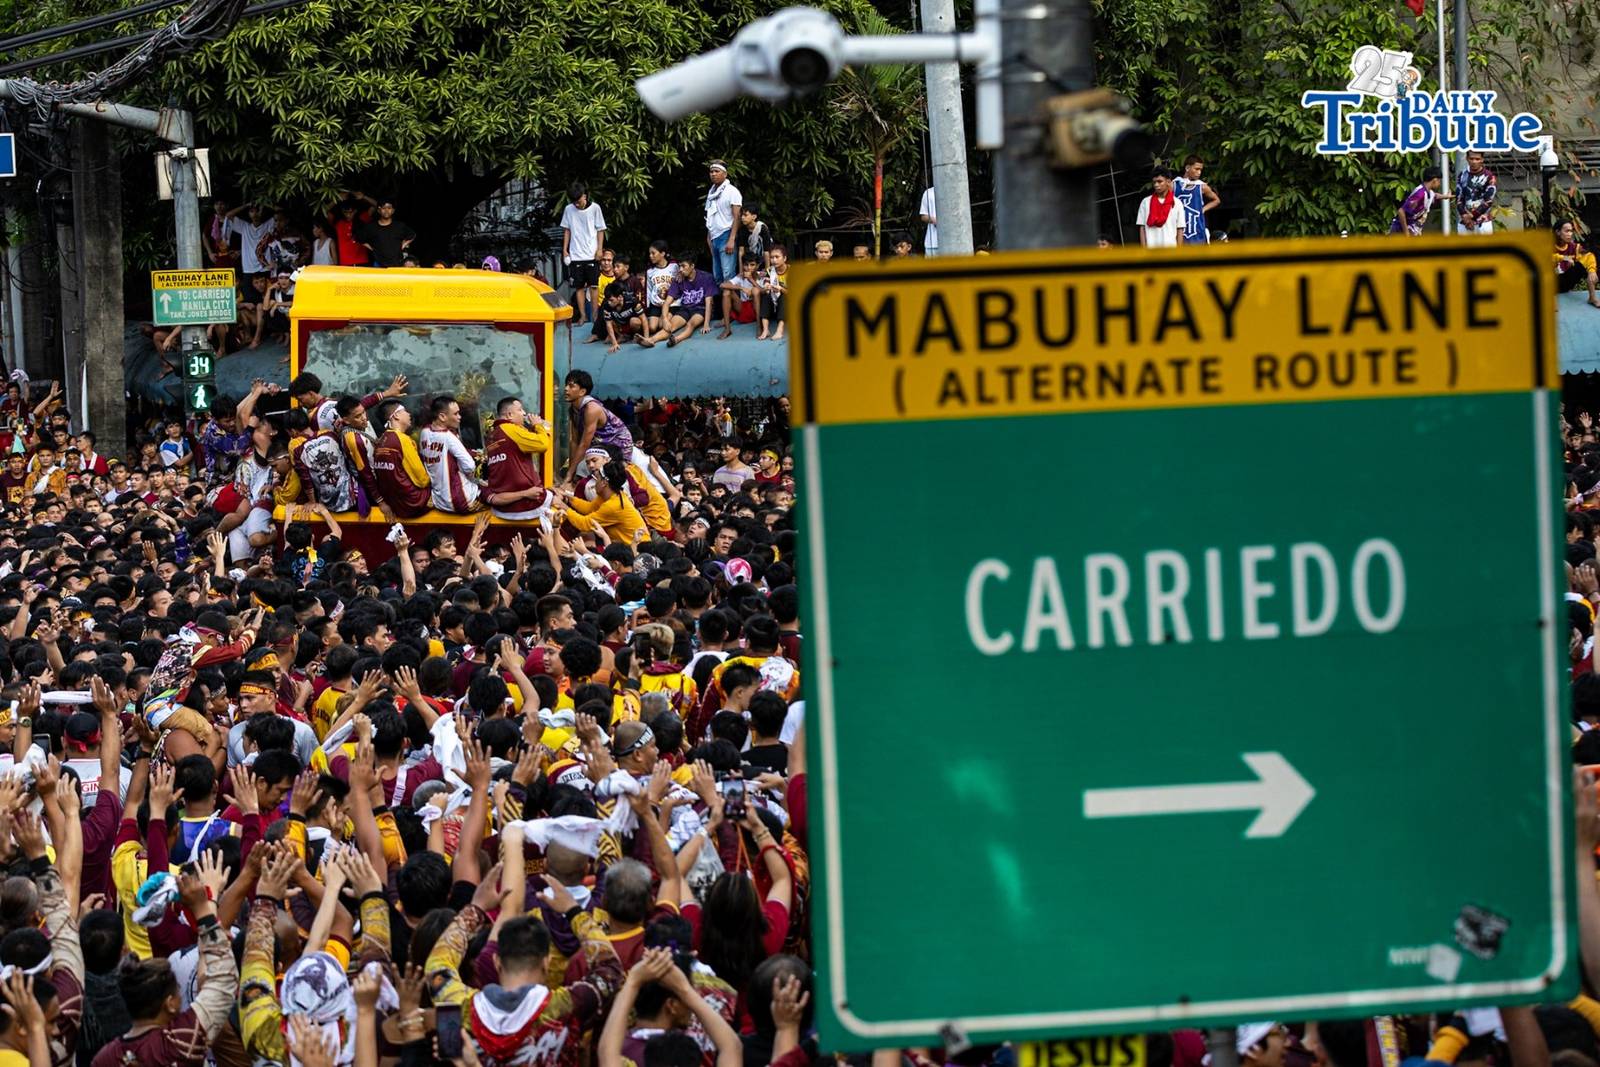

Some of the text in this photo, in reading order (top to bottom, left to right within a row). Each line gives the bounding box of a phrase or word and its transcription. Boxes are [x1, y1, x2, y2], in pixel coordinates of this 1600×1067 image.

[158, 273, 229, 282] MABUHAY LANE
[178, 289, 231, 300] TO: CARRIEDO
[170, 309, 232, 319] TAKE JONES BRIDGE
[181, 300, 231, 311] MANILA CITY
[843, 266, 1502, 360] MABUHAY LANE
[189, 355, 210, 376] 34
[937, 355, 1223, 407] ALTERNATE
[1254, 347, 1418, 394] ROUTE
[964, 537, 1407, 656] CARRIEDO
[1032, 1033, 1137, 1067] JESUS
